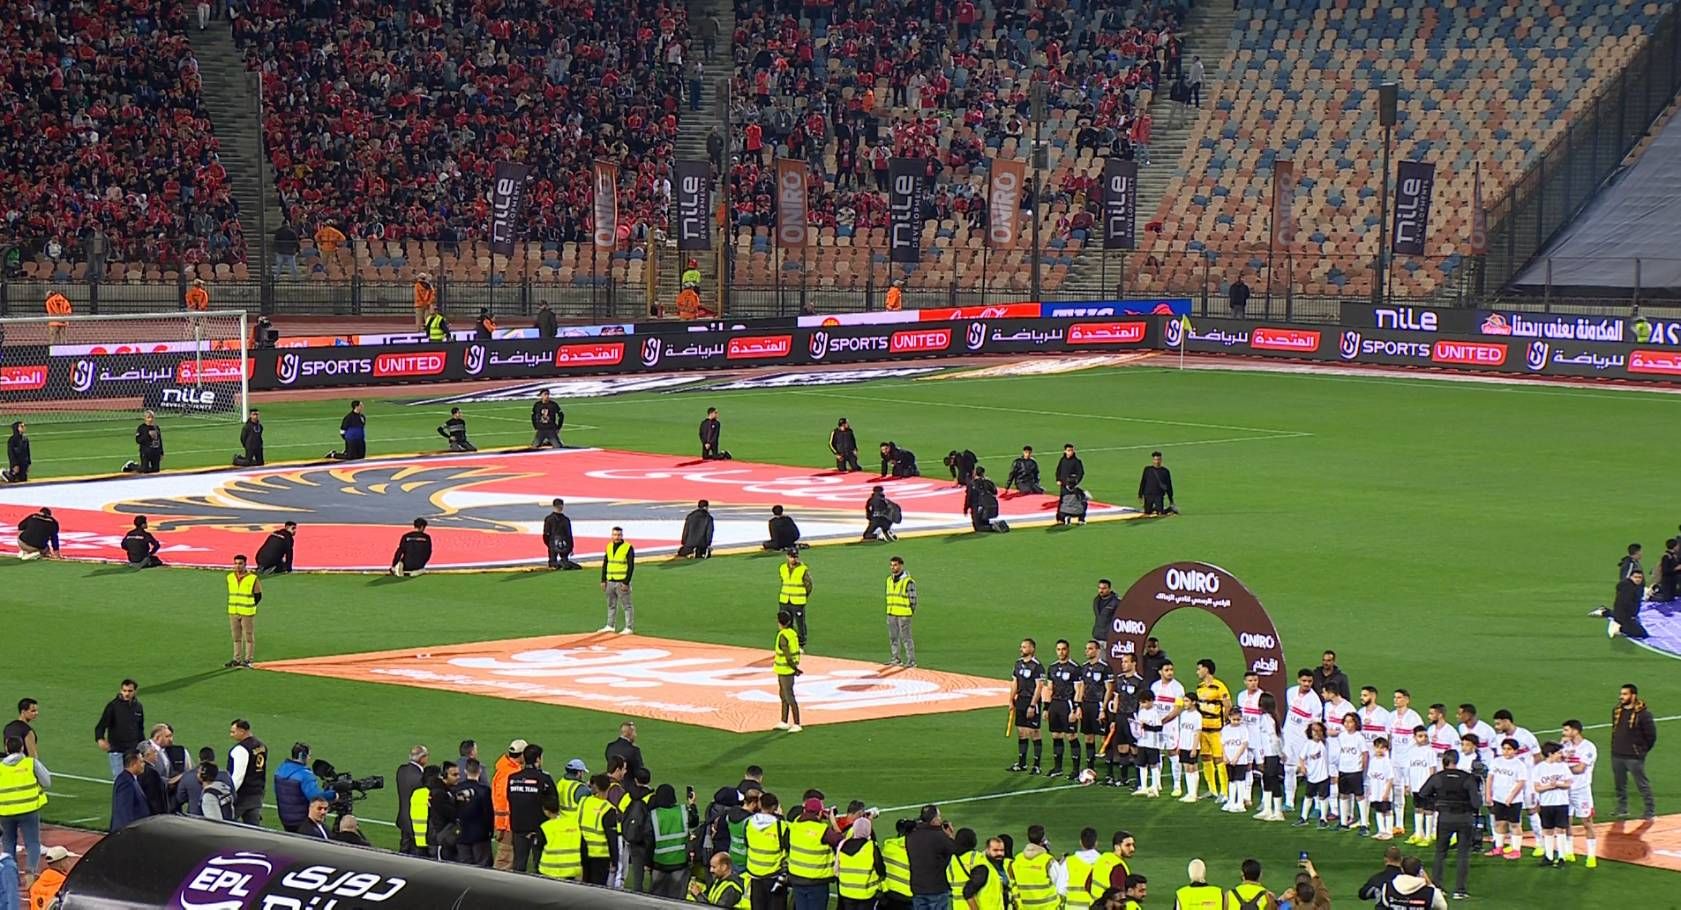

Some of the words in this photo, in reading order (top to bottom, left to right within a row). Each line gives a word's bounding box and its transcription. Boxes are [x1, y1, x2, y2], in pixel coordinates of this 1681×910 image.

[991, 172, 1017, 243] ONIRO
[991, 327, 1063, 345] للرياضة
[1072, 325, 1139, 339] المتحدة
[1255, 331, 1314, 348] المتحدة
[665, 343, 724, 359] للرياضة
[731, 340, 786, 353] المتحدة
[829, 336, 888, 351] SPORTS
[894, 333, 947, 348] UNITED
[1362, 340, 1430, 357] SPORTS
[1437, 345, 1502, 361] UNITED
[489, 350, 553, 367] للرياضة
[559, 347, 619, 362] المتحدة
[1553, 350, 1625, 369] للرياضة
[301, 358, 372, 376] SPORTS
[378, 355, 441, 373] UNITED
[100, 366, 174, 386] للرياضة
[1166, 568, 1220, 594] ONIRO
[1113, 618, 1146, 635] ONIRO
[1240, 632, 1275, 649] ONIRO
[188, 866, 252, 897] EPL
